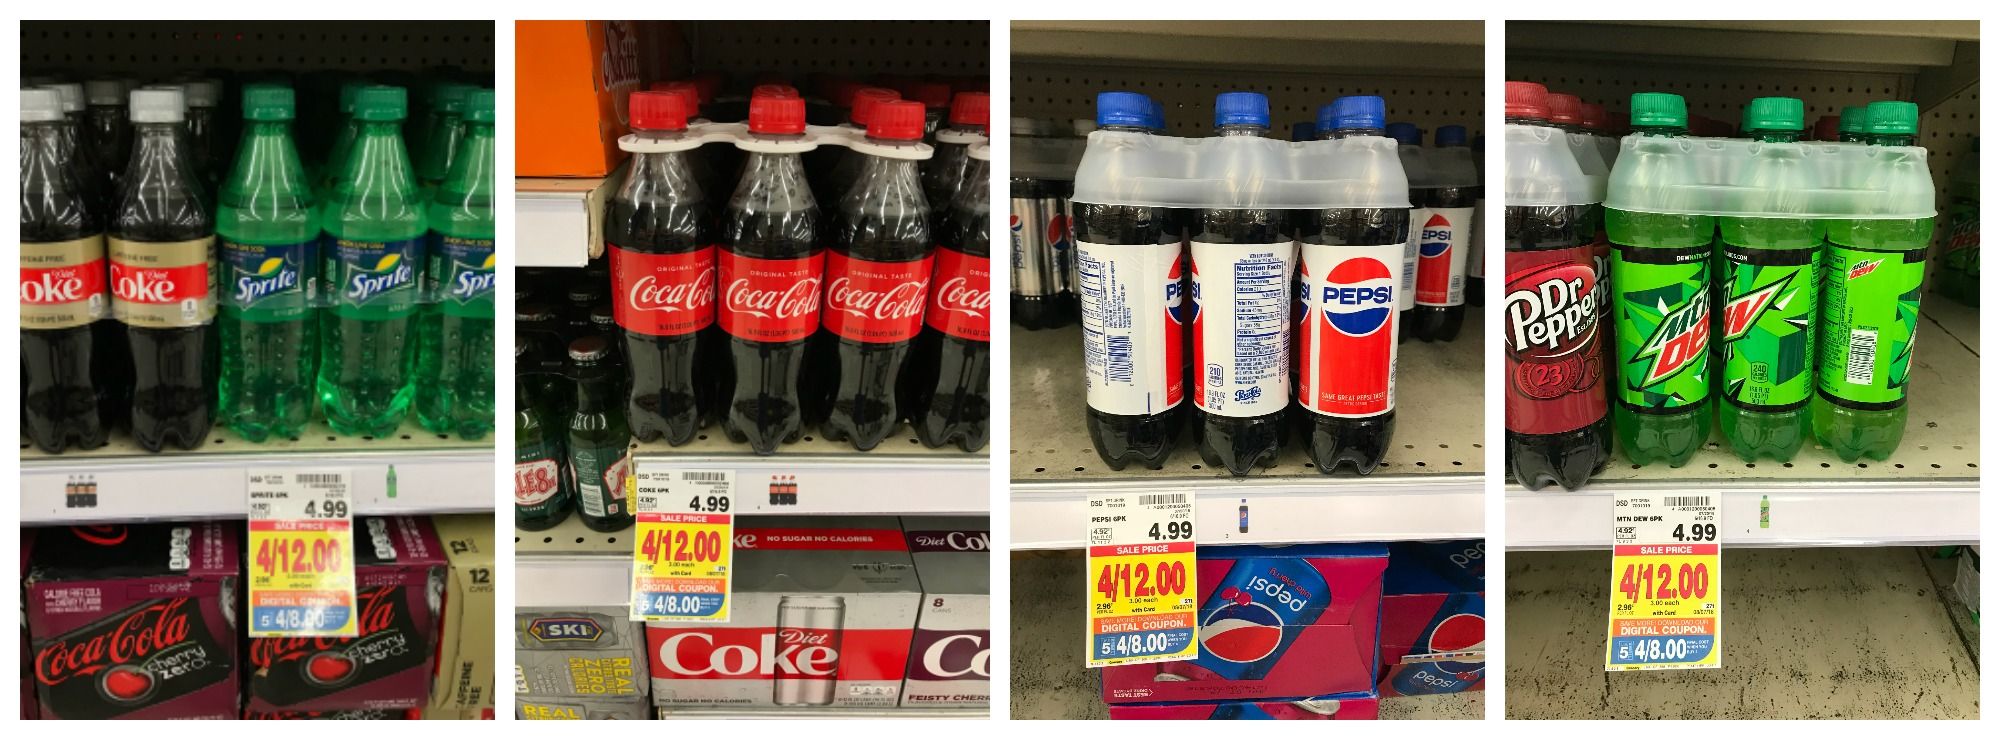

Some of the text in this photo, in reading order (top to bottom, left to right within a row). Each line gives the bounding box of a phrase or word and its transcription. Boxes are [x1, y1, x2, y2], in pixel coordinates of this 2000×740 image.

[656, 264, 693, 272] ORIGINAL
[750, 270, 786, 278] ORIGINAL
[851, 270, 887, 279] ORIGINAL
[20, 271, 82, 303] oke
[110, 264, 175, 303] Coke
[235, 268, 297, 303] Sprite
[348, 263, 411, 300] Sprite
[828, 277, 929, 320] Coca-Cola
[1323, 286, 1393, 305] PEPSI
[1539, 277, 1583, 318] Dr
[1505, 284, 1598, 351] Pepper
[1535, 364, 1564, 387] 23
[1322, 391, 1336, 400] SAME
[304, 500, 348, 518] 4.99
[689, 495, 730, 512] 4.99
[660, 514, 708, 523] SALE PRICE
[733, 534, 757, 548] ke
[915, 536, 944, 546] Diet
[1148, 521, 1193, 541] 4.99
[1672, 523, 1716, 542] 4.99
[256, 538, 341, 577] 4/12.00
[641, 529, 721, 565] 4/12.00
[1142, 545, 1169, 554] PRICE
[1640, 546, 1693, 554] SALE PRICE
[469, 568, 490, 584] 12
[1098, 561, 1186, 603] 4/12.00
[1620, 563, 1709, 603] 4/12.00
[642, 584, 676, 592] DIGITAL
[1245, 574, 1308, 613] pepsi
[654, 595, 700, 614] 4/8.00
[933, 598, 944, 607] 8
[275, 608, 325, 630] 4/8.00
[548, 624, 588, 636] SKI
[1101, 620, 1187, 633] DIGITAL COUPON.
[35, 596, 190, 686] Coca-Cola
[779, 628, 829, 644] Diet
[1620, 626, 1659, 636] DIGITAL
[350, 634, 406, 660] cherry
[659, 632, 838, 676] Coke
[1101, 642, 1111, 655] 5
[1117, 632, 1168, 656] 4/8.00
[1619, 639, 1687, 663] 5 4/8.00
[146, 646, 206, 673] cherry
[160, 658, 206, 680] zero
[585, 658, 606, 694] ZERO
[613, 657, 635, 695] REAL
